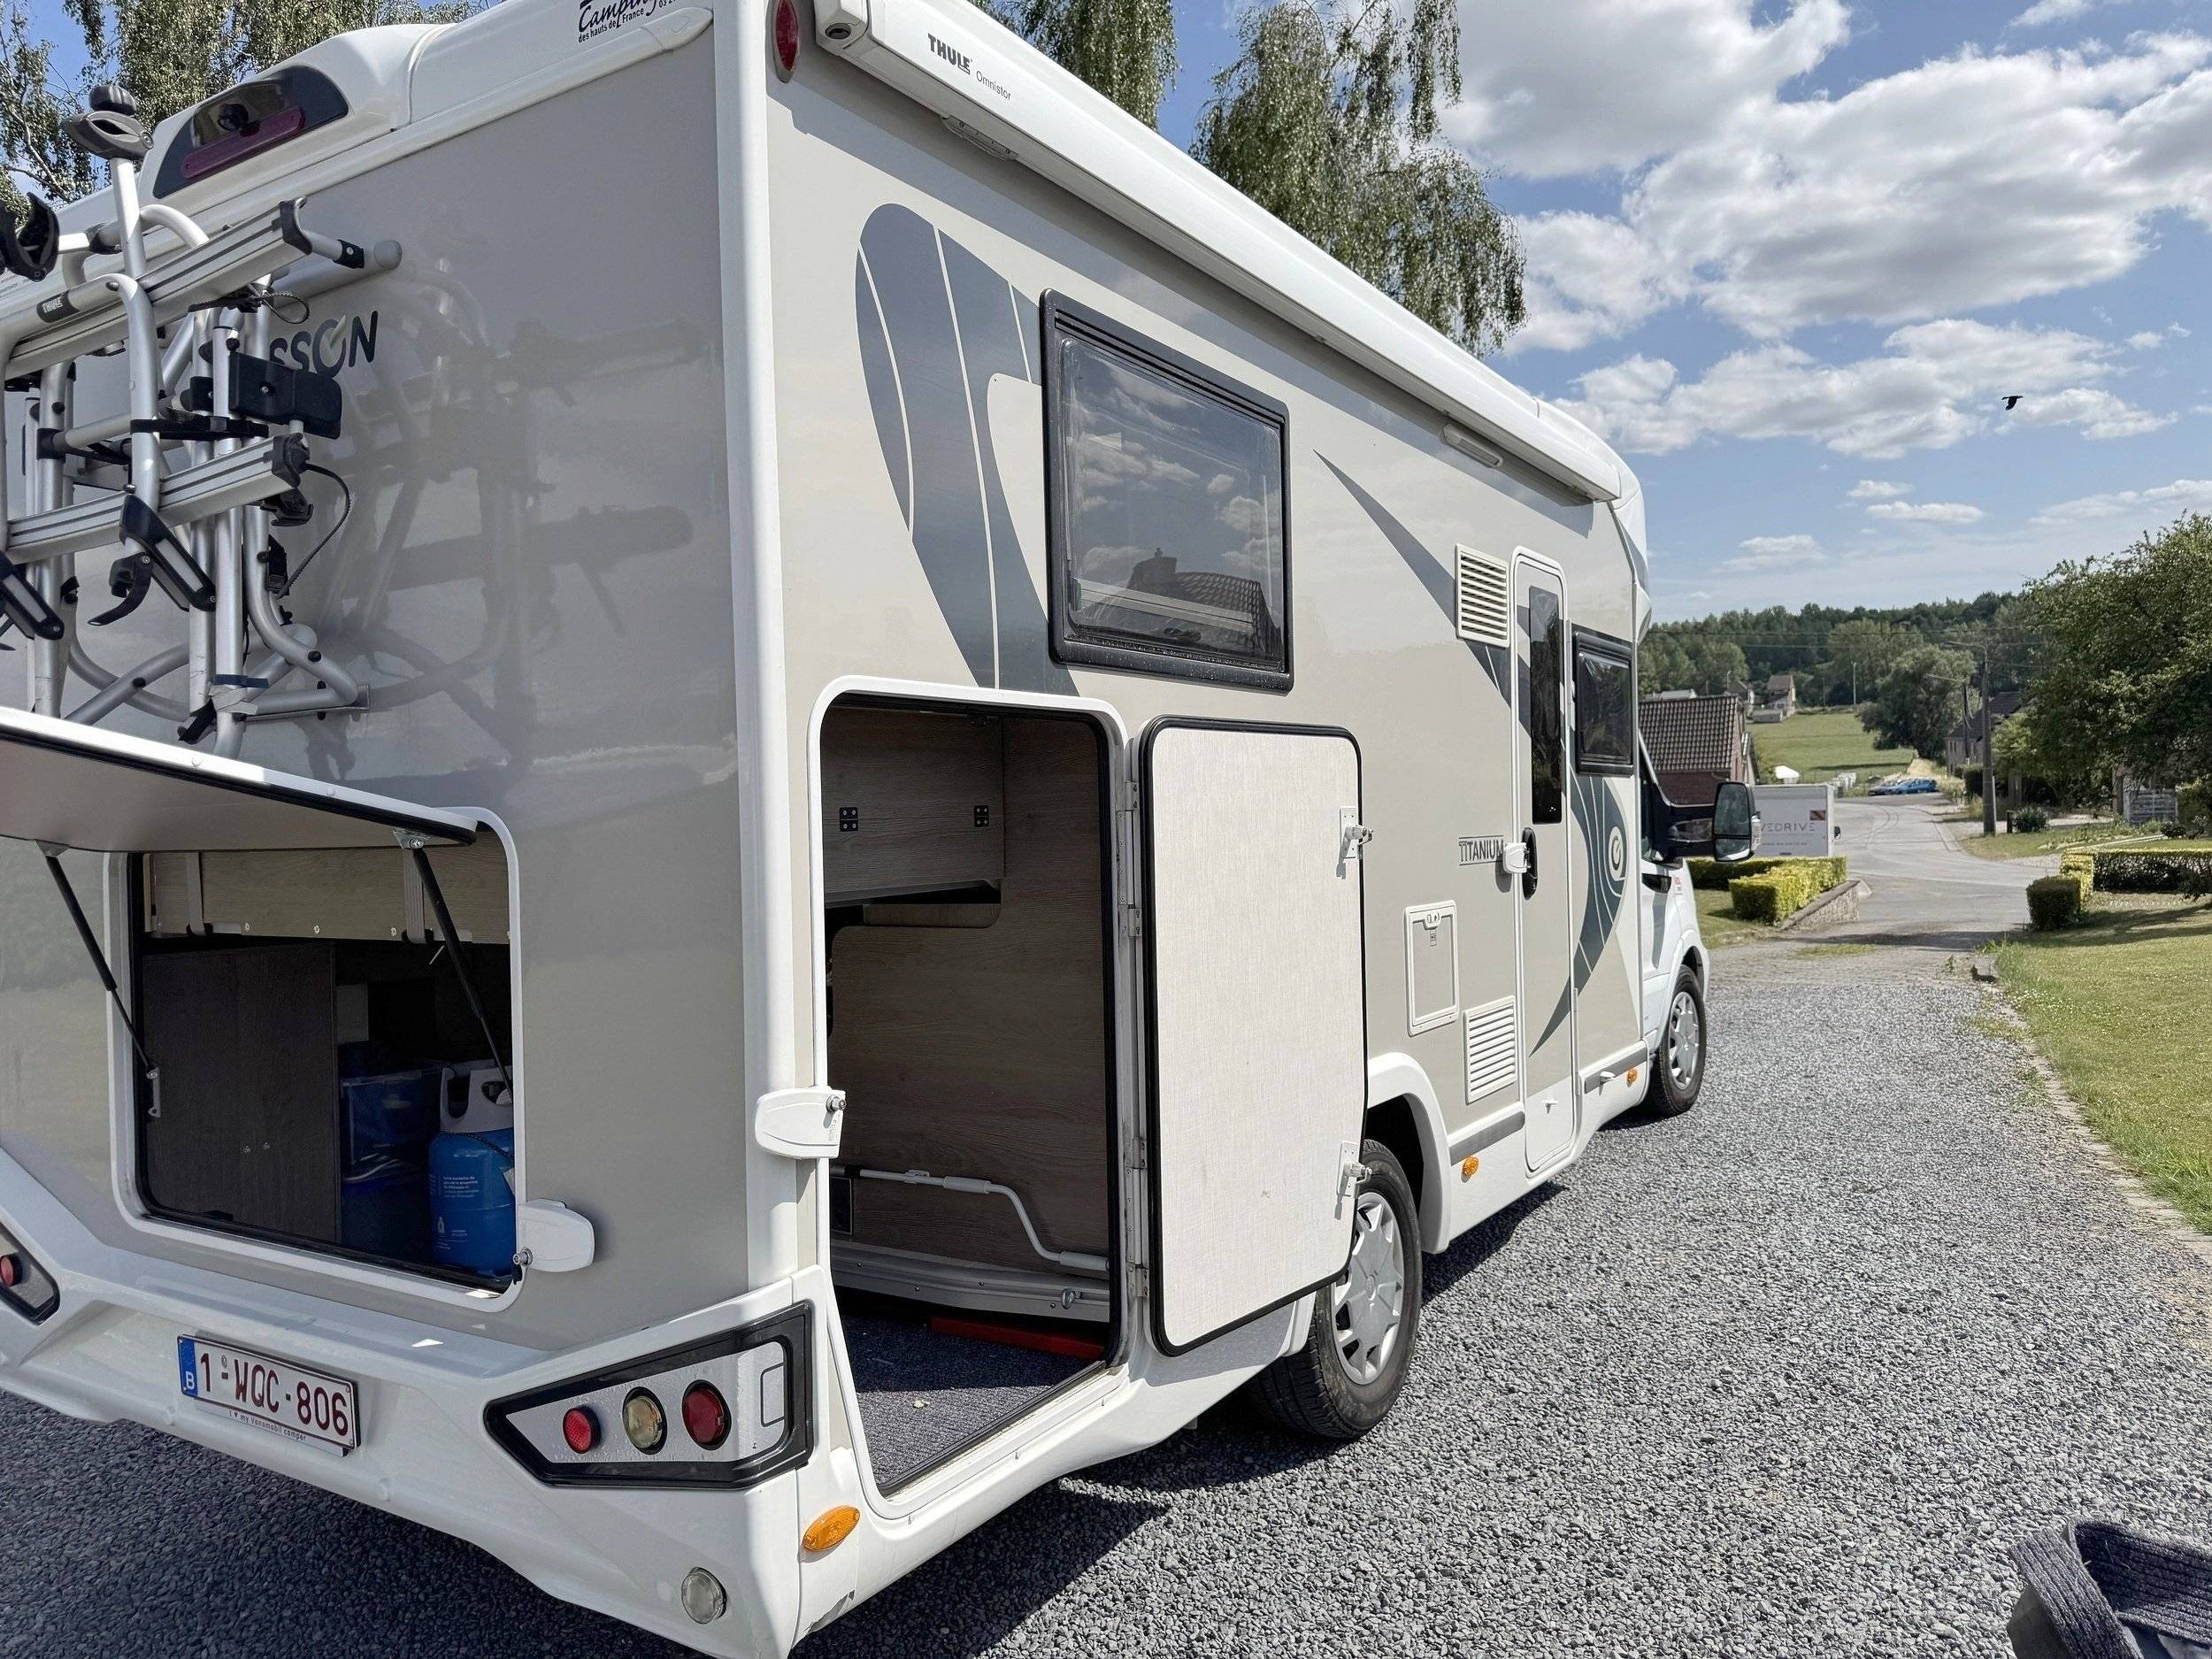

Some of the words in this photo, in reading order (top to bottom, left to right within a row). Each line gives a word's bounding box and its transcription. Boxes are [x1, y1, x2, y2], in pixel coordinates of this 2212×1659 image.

[578, 32, 589, 43] des
[590, 25, 608, 38] hauts
[608, 19, 617, 29] de
[622, 7, 645, 24] France
[927, 32, 971, 75] THULE
[976, 70, 1012, 101] Omnistor
[1458, 839, 1504, 863] TITANIUM
[185, 1371, 196, 1390] B
[283, 1428, 307, 1441] camper
